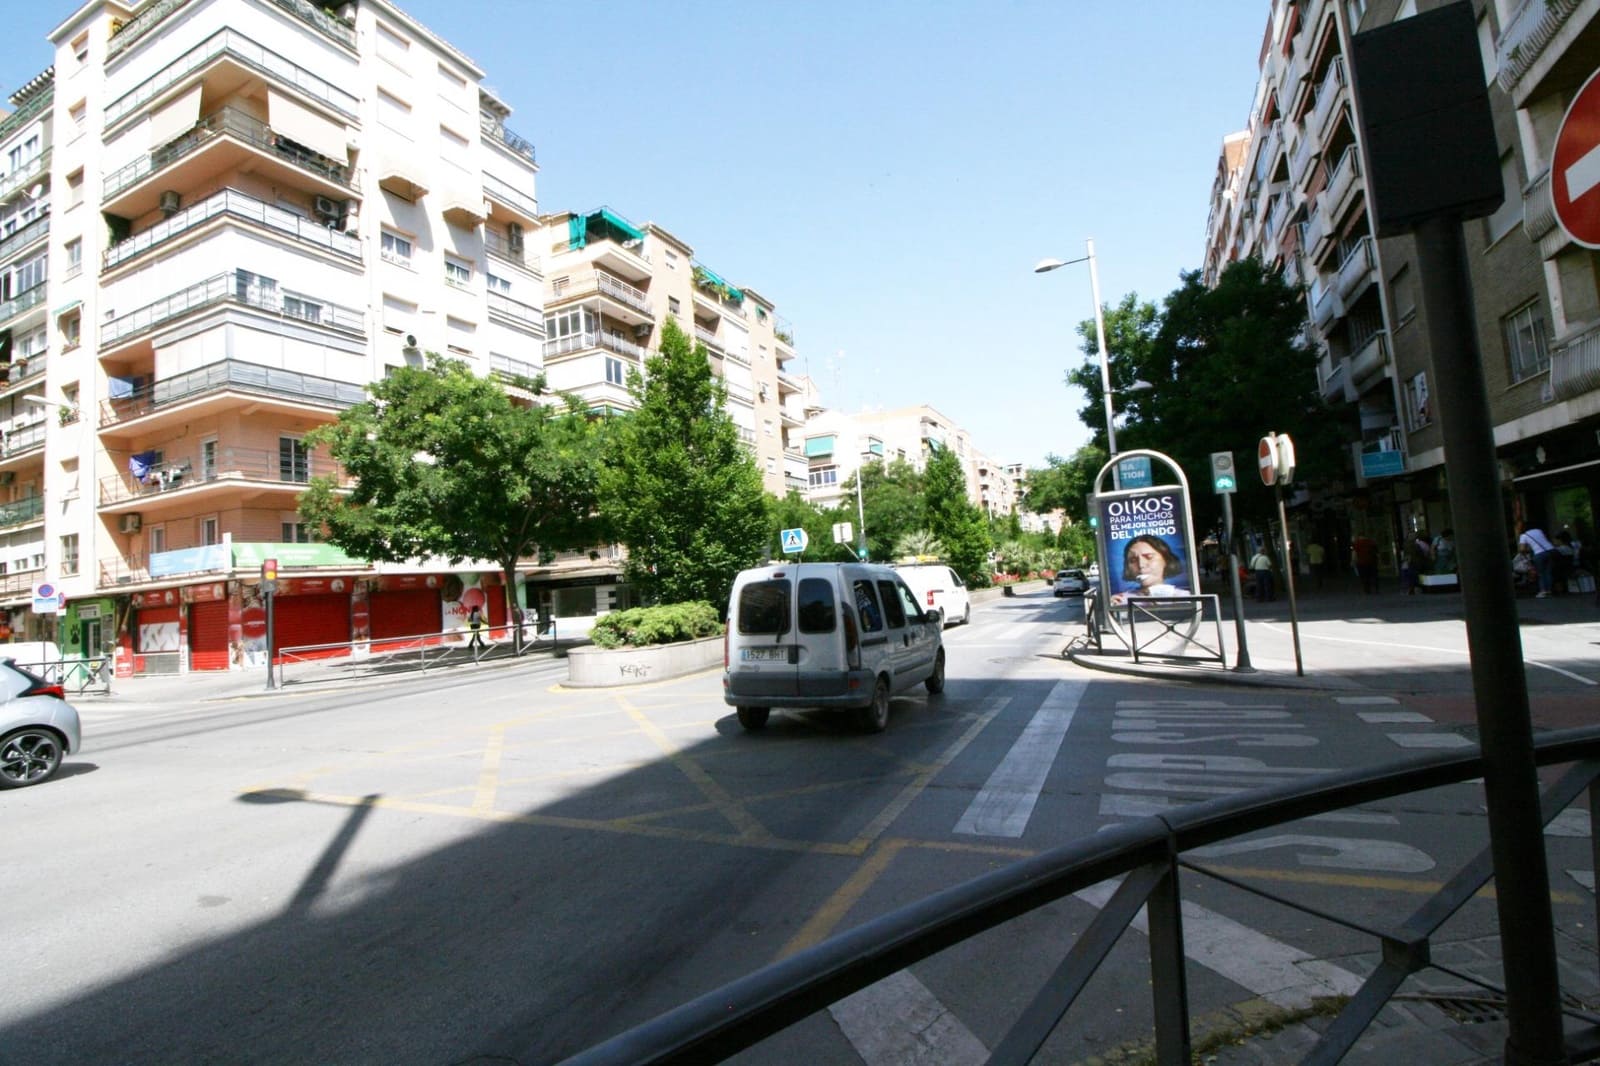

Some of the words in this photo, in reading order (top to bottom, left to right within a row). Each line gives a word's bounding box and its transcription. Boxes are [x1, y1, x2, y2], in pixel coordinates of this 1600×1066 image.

[1108, 496, 1174, 516] OIKOS
[1109, 515, 1133, 524] PARA
[1133, 511, 1174, 521] MUCHOS
[1121, 521, 1146, 530] MEJOR
[1147, 519, 1175, 527] YOGUR
[1111, 530, 1132, 540] DEL
[1134, 526, 1176, 538] MUNDO
[1111, 700, 1321, 747] STOP
